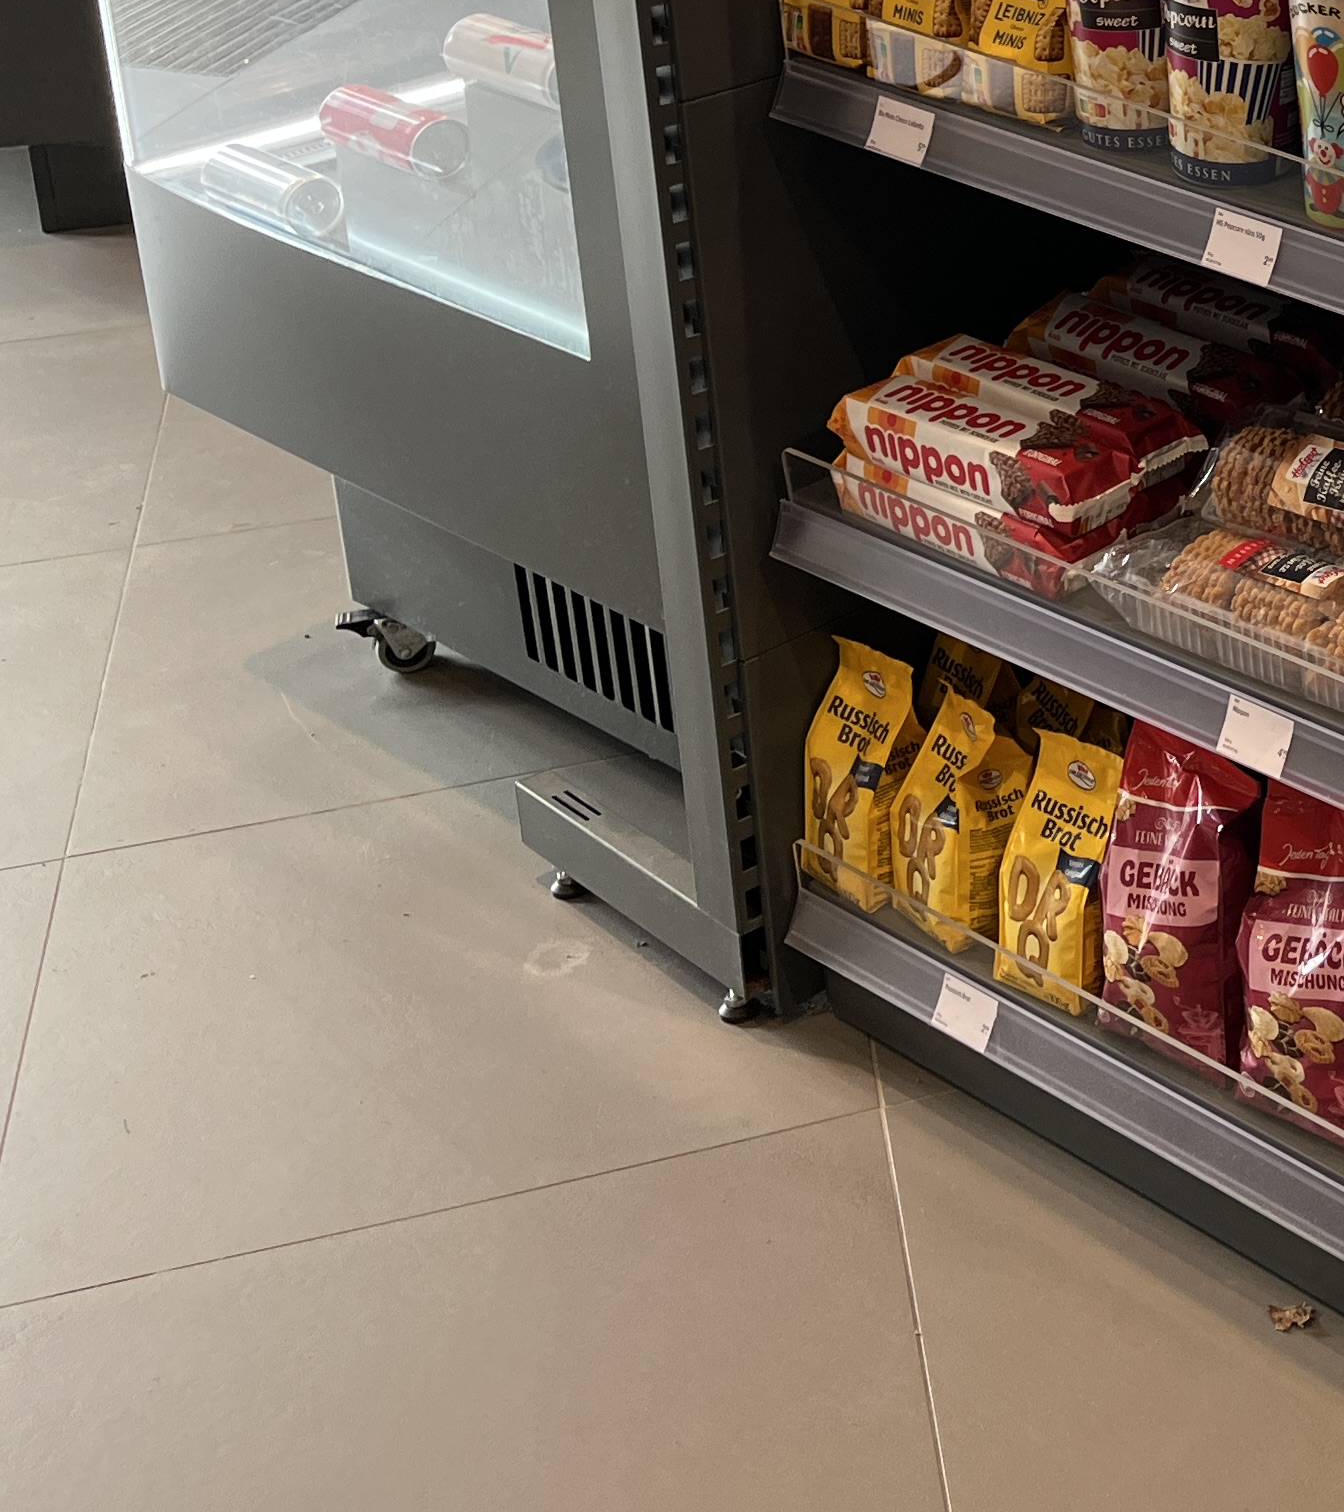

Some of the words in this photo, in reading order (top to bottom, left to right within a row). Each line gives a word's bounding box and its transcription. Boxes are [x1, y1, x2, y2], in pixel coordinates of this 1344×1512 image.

[893, 4, 925, 26] MINIS
[994, 1, 1046, 27] LEIBNIZ
[1095, 14, 1139, 28] sweet
[992, 29, 1026, 49] MINIS
[1169, 35, 1198, 56] sweet
[1187, 160, 1232, 182] ESSEN
[1053, 307, 1191, 371] nippon
[949, 342, 1087, 400] nippon
[883, 381, 1027, 440] nippon
[864, 424, 991, 497] nippon
[1292, 447, 1320, 479] Hofgut
[858, 483, 975, 557] nippon
[826, 695, 890, 745] Russisch
[837, 722, 872, 758] Brot
[975, 788, 1024, 813] Russisch
[986, 803, 1015, 824] Brot
[1030, 789, 1110, 840] Russisch
[1039, 819, 1081, 852] Brot
